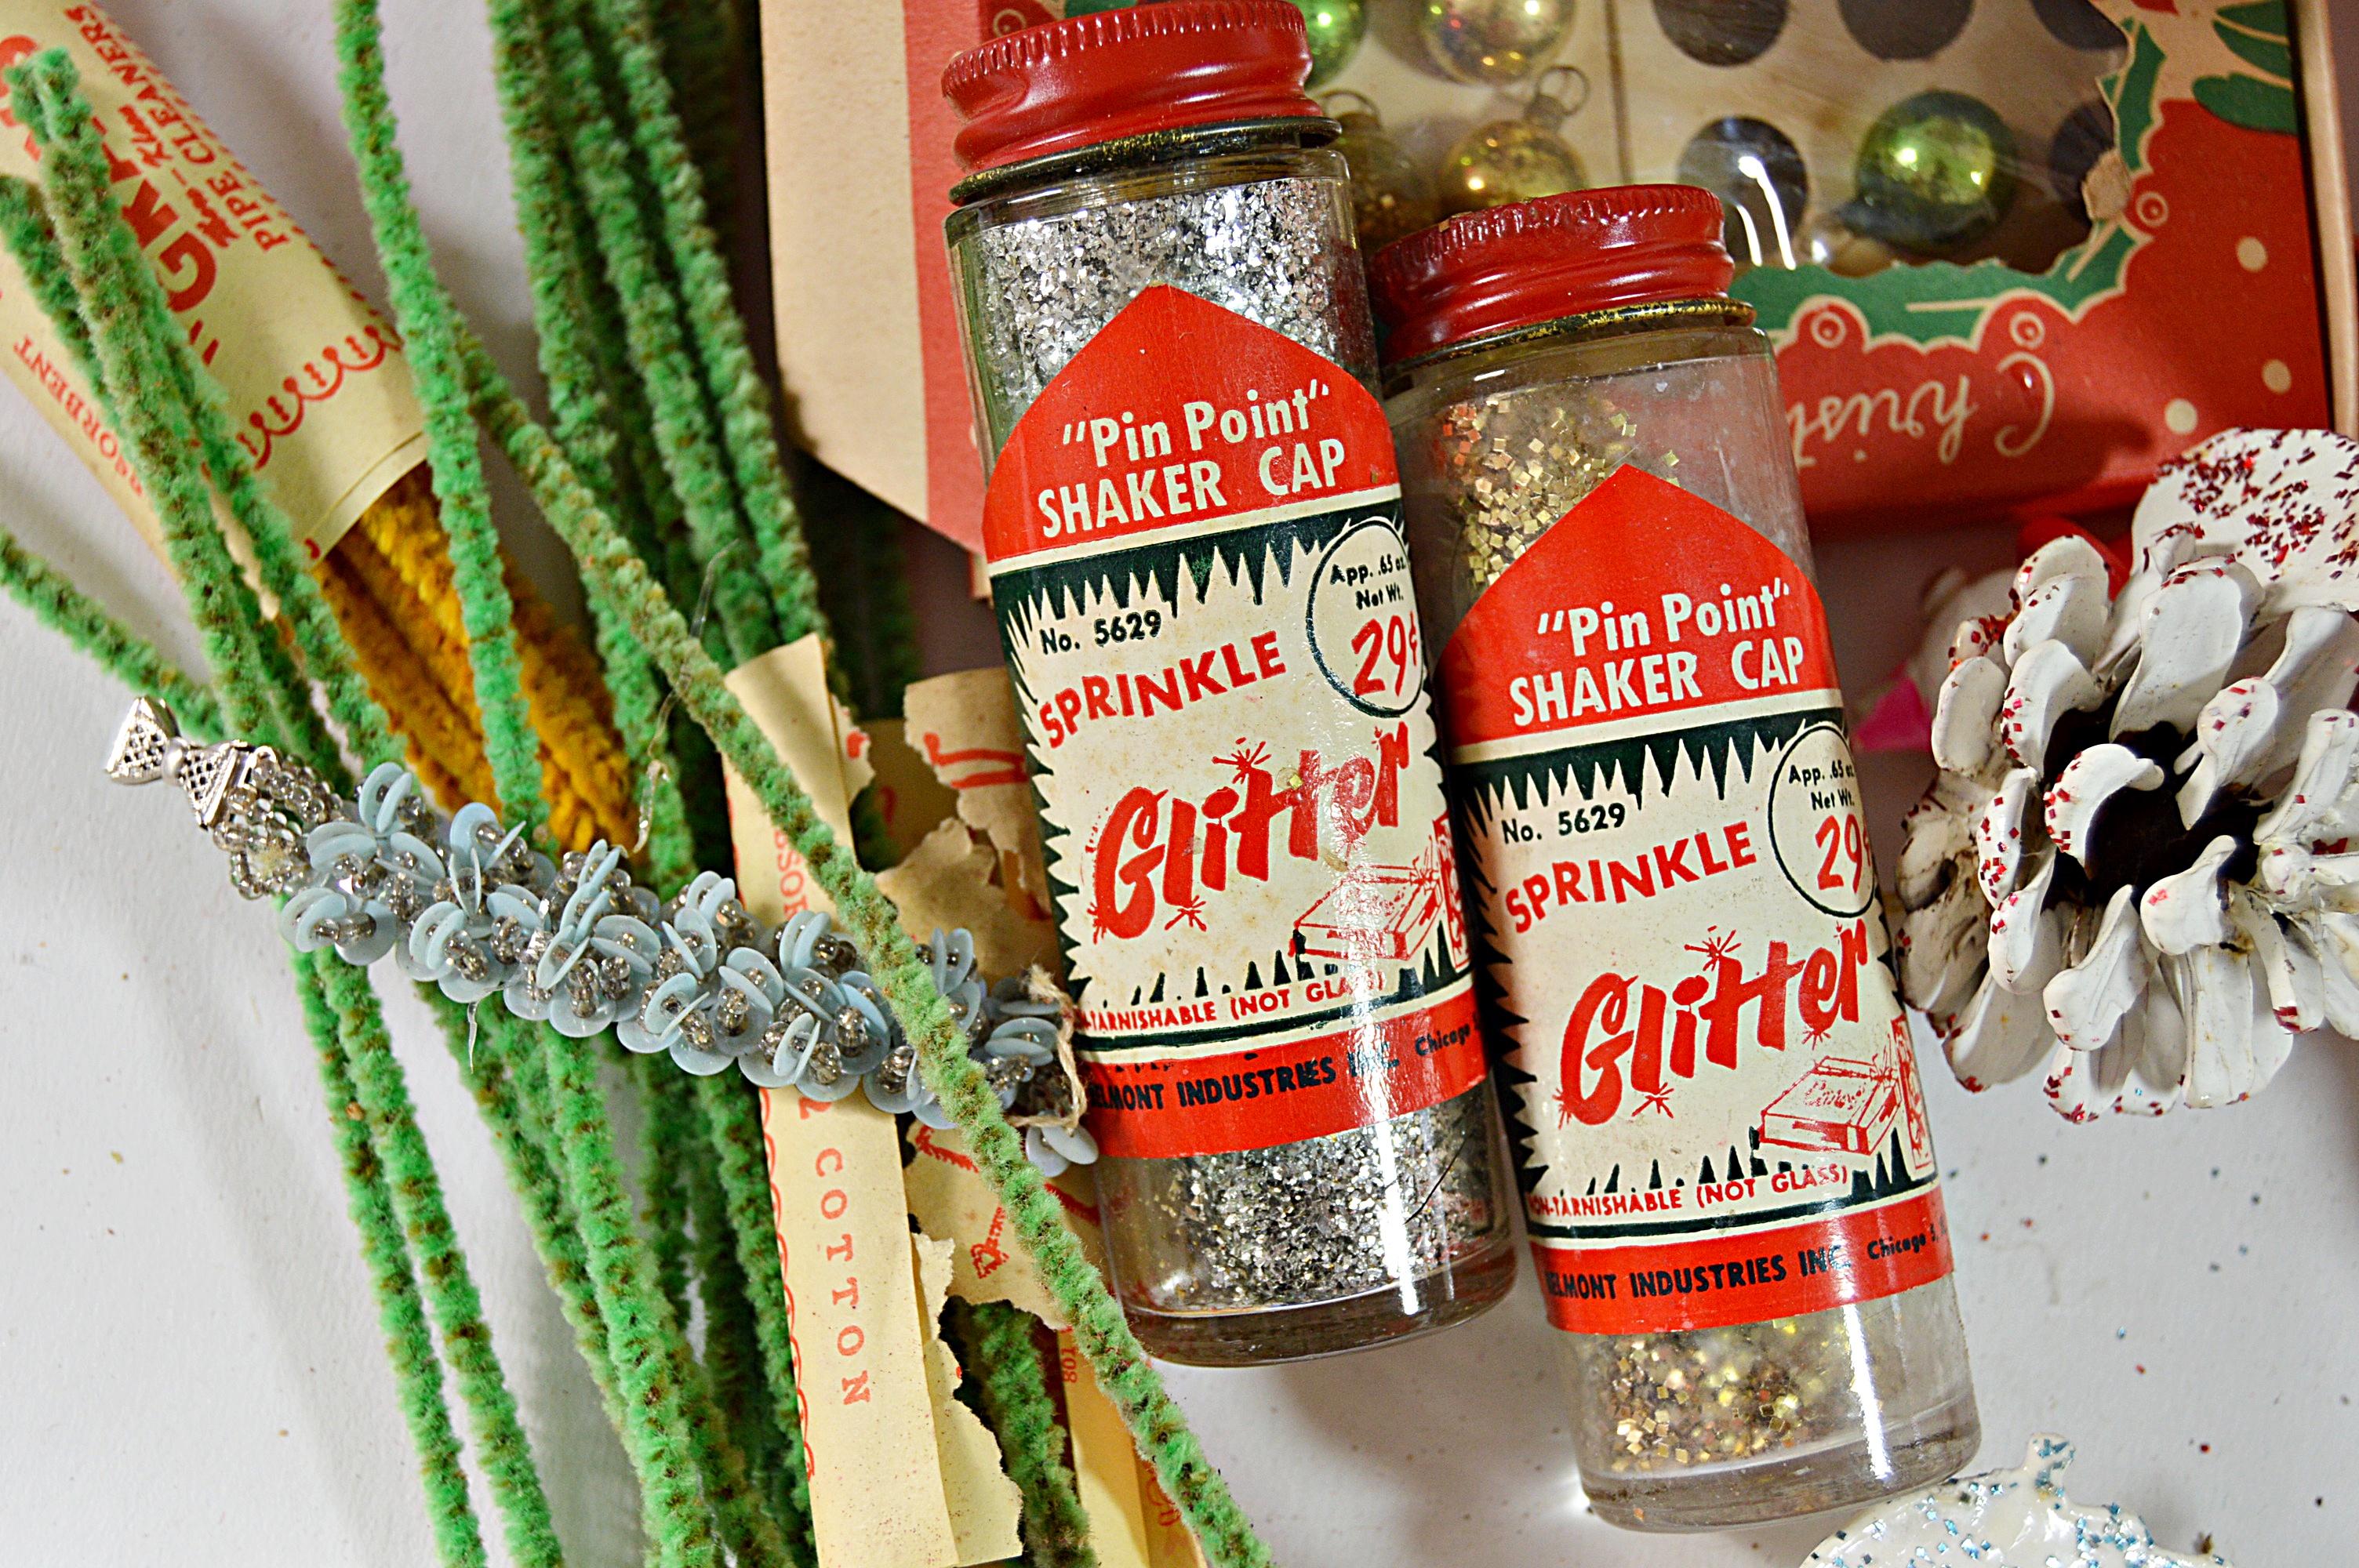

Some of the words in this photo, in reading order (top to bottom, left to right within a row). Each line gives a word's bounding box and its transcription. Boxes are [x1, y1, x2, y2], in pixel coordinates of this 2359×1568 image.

[64, 5, 216, 165] CLEANERS
[206, 170, 290, 251] PIPE
[1063, 411, 1172, 467] "Pin
[1183, 379, 1329, 452] Point"
[1038, 460, 1227, 539] SHAKER
[1259, 438, 1345, 495] CAP
[1330, 564, 1373, 586] App.
[1356, 589, 1383, 610] Net
[1386, 583, 1404, 602] Wt.
[1040, 627, 1080, 655] No.
[1094, 609, 1161, 647] 5629
[1351, 611, 1418, 697] 29¢
[1538, 601, 1651, 657] "Pin
[1662, 577, 1790, 642] Point"
[1039, 630, 1286, 749] SPRINKLE
[1510, 651, 1703, 727] SHAKER
[1732, 637, 1805, 690] CAP
[1789, 764, 1826, 787] App.
[1811, 791, 1835, 811] Net
[1837, 788, 1855, 807] Wt.
[1094, 721, 1409, 939] Glitter
[1502, 818, 1543, 844] No.
[1558, 802, 1626, 837] 5629
[1506, 820, 1757, 934] SPRINKLE
[1230, 989, 1290, 1020] (NOT
[1560, 919, 1868, 1126] Glitter
[1176, 1056, 1336, 1107] INDUSTRIES
[1415, 1022, 1470, 1057] Chicago
[1697, 1178, 1756, 1208] (NOT
[1772, 1163, 1848, 1193] GLASS)
[815, 1147, 871, 1406] COTTON
[1630, 1254, 1787, 1299] INDUSTRIES
[1867, 1232, 1926, 1261] Chicago
[1060, 1345, 1078, 1384] 801
